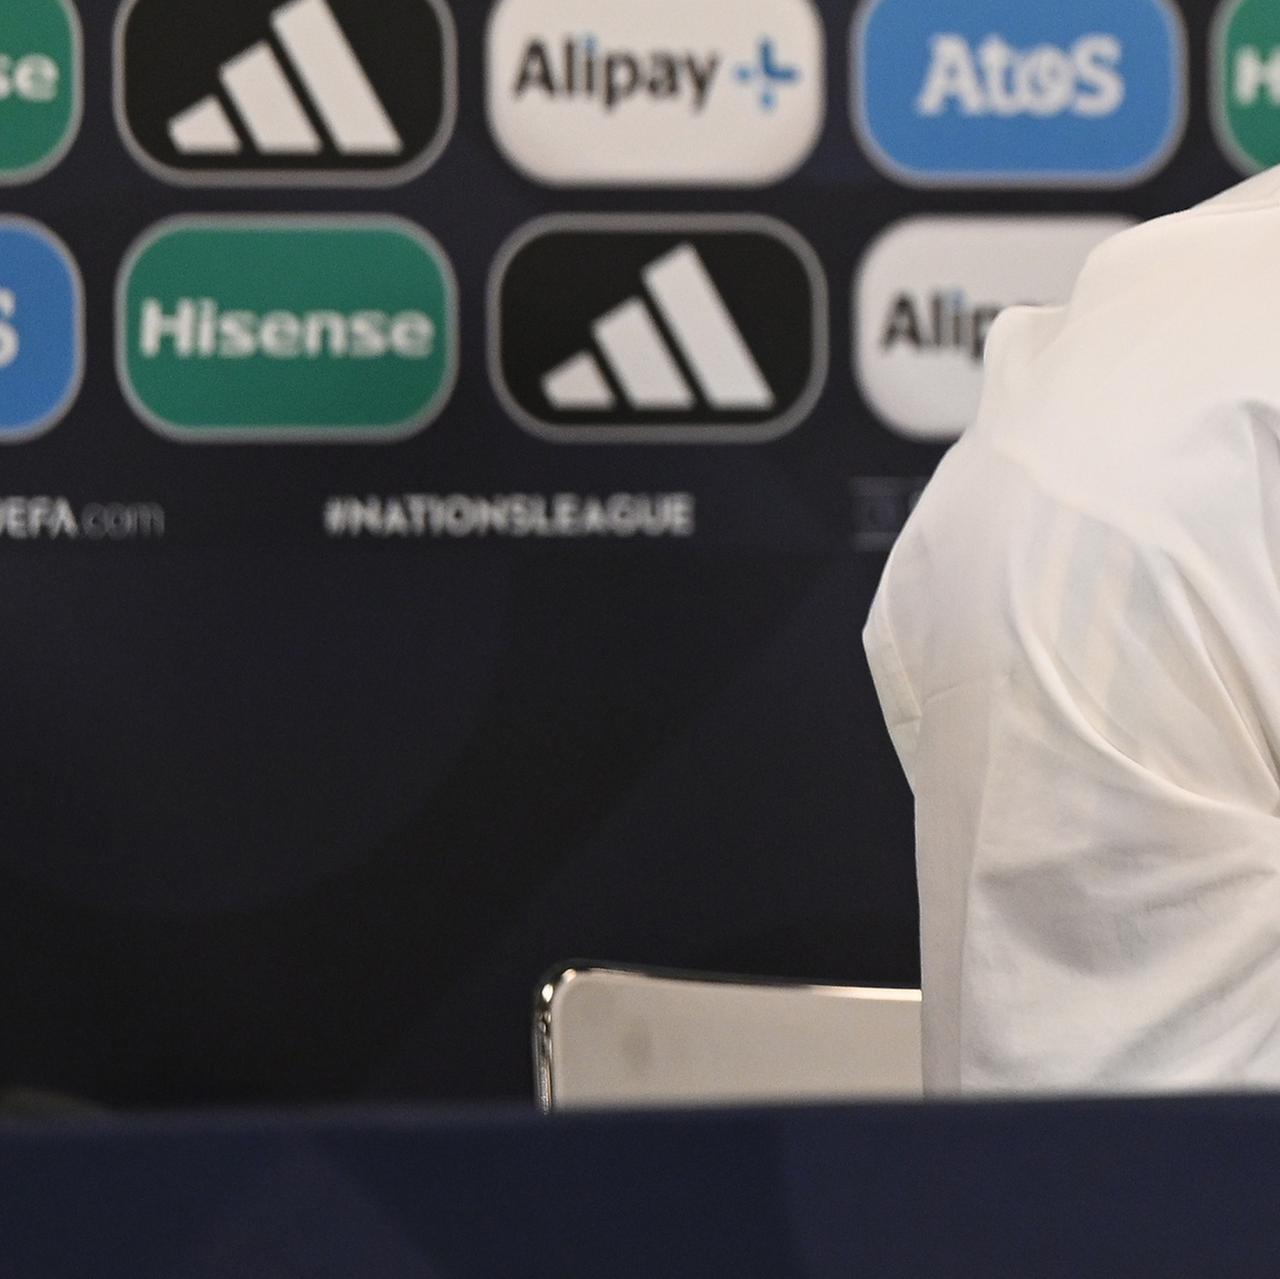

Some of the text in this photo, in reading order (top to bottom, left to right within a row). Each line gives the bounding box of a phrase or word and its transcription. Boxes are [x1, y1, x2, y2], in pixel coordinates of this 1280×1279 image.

[139, 298, 433, 357] Hisense
[881, 287, 1001, 366] Alip
[324, 493, 693, 535] #NATIONSLEAGUE
